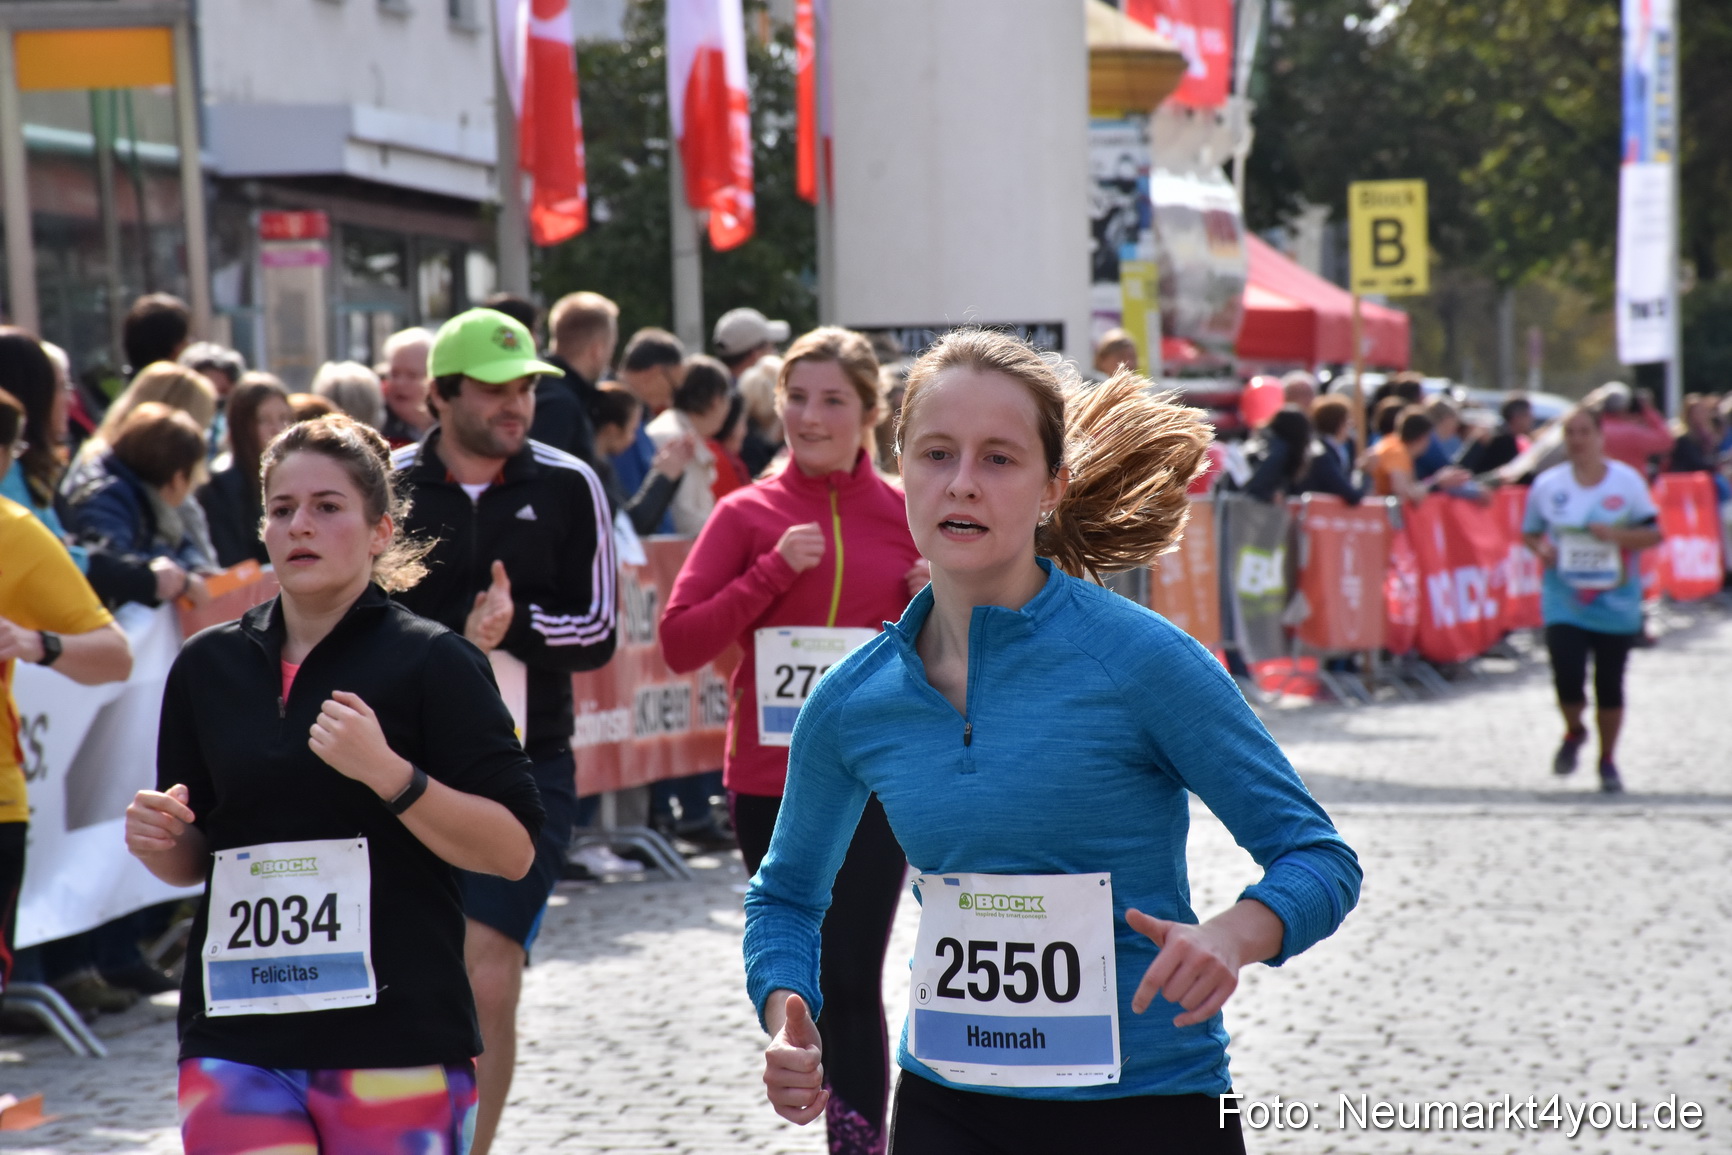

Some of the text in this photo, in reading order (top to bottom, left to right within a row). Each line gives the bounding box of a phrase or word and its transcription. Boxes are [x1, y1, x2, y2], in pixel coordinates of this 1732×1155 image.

[1371, 217, 1406, 269] B
[262, 857, 318, 874] BOCK
[975, 894, 1046, 912] BOCK
[228, 893, 341, 950] 2034
[251, 964, 319, 985] Felicitas
[935, 937, 1081, 1004] 2550
[920, 988, 927, 1000] D
[966, 1024, 1047, 1049] Hannah
